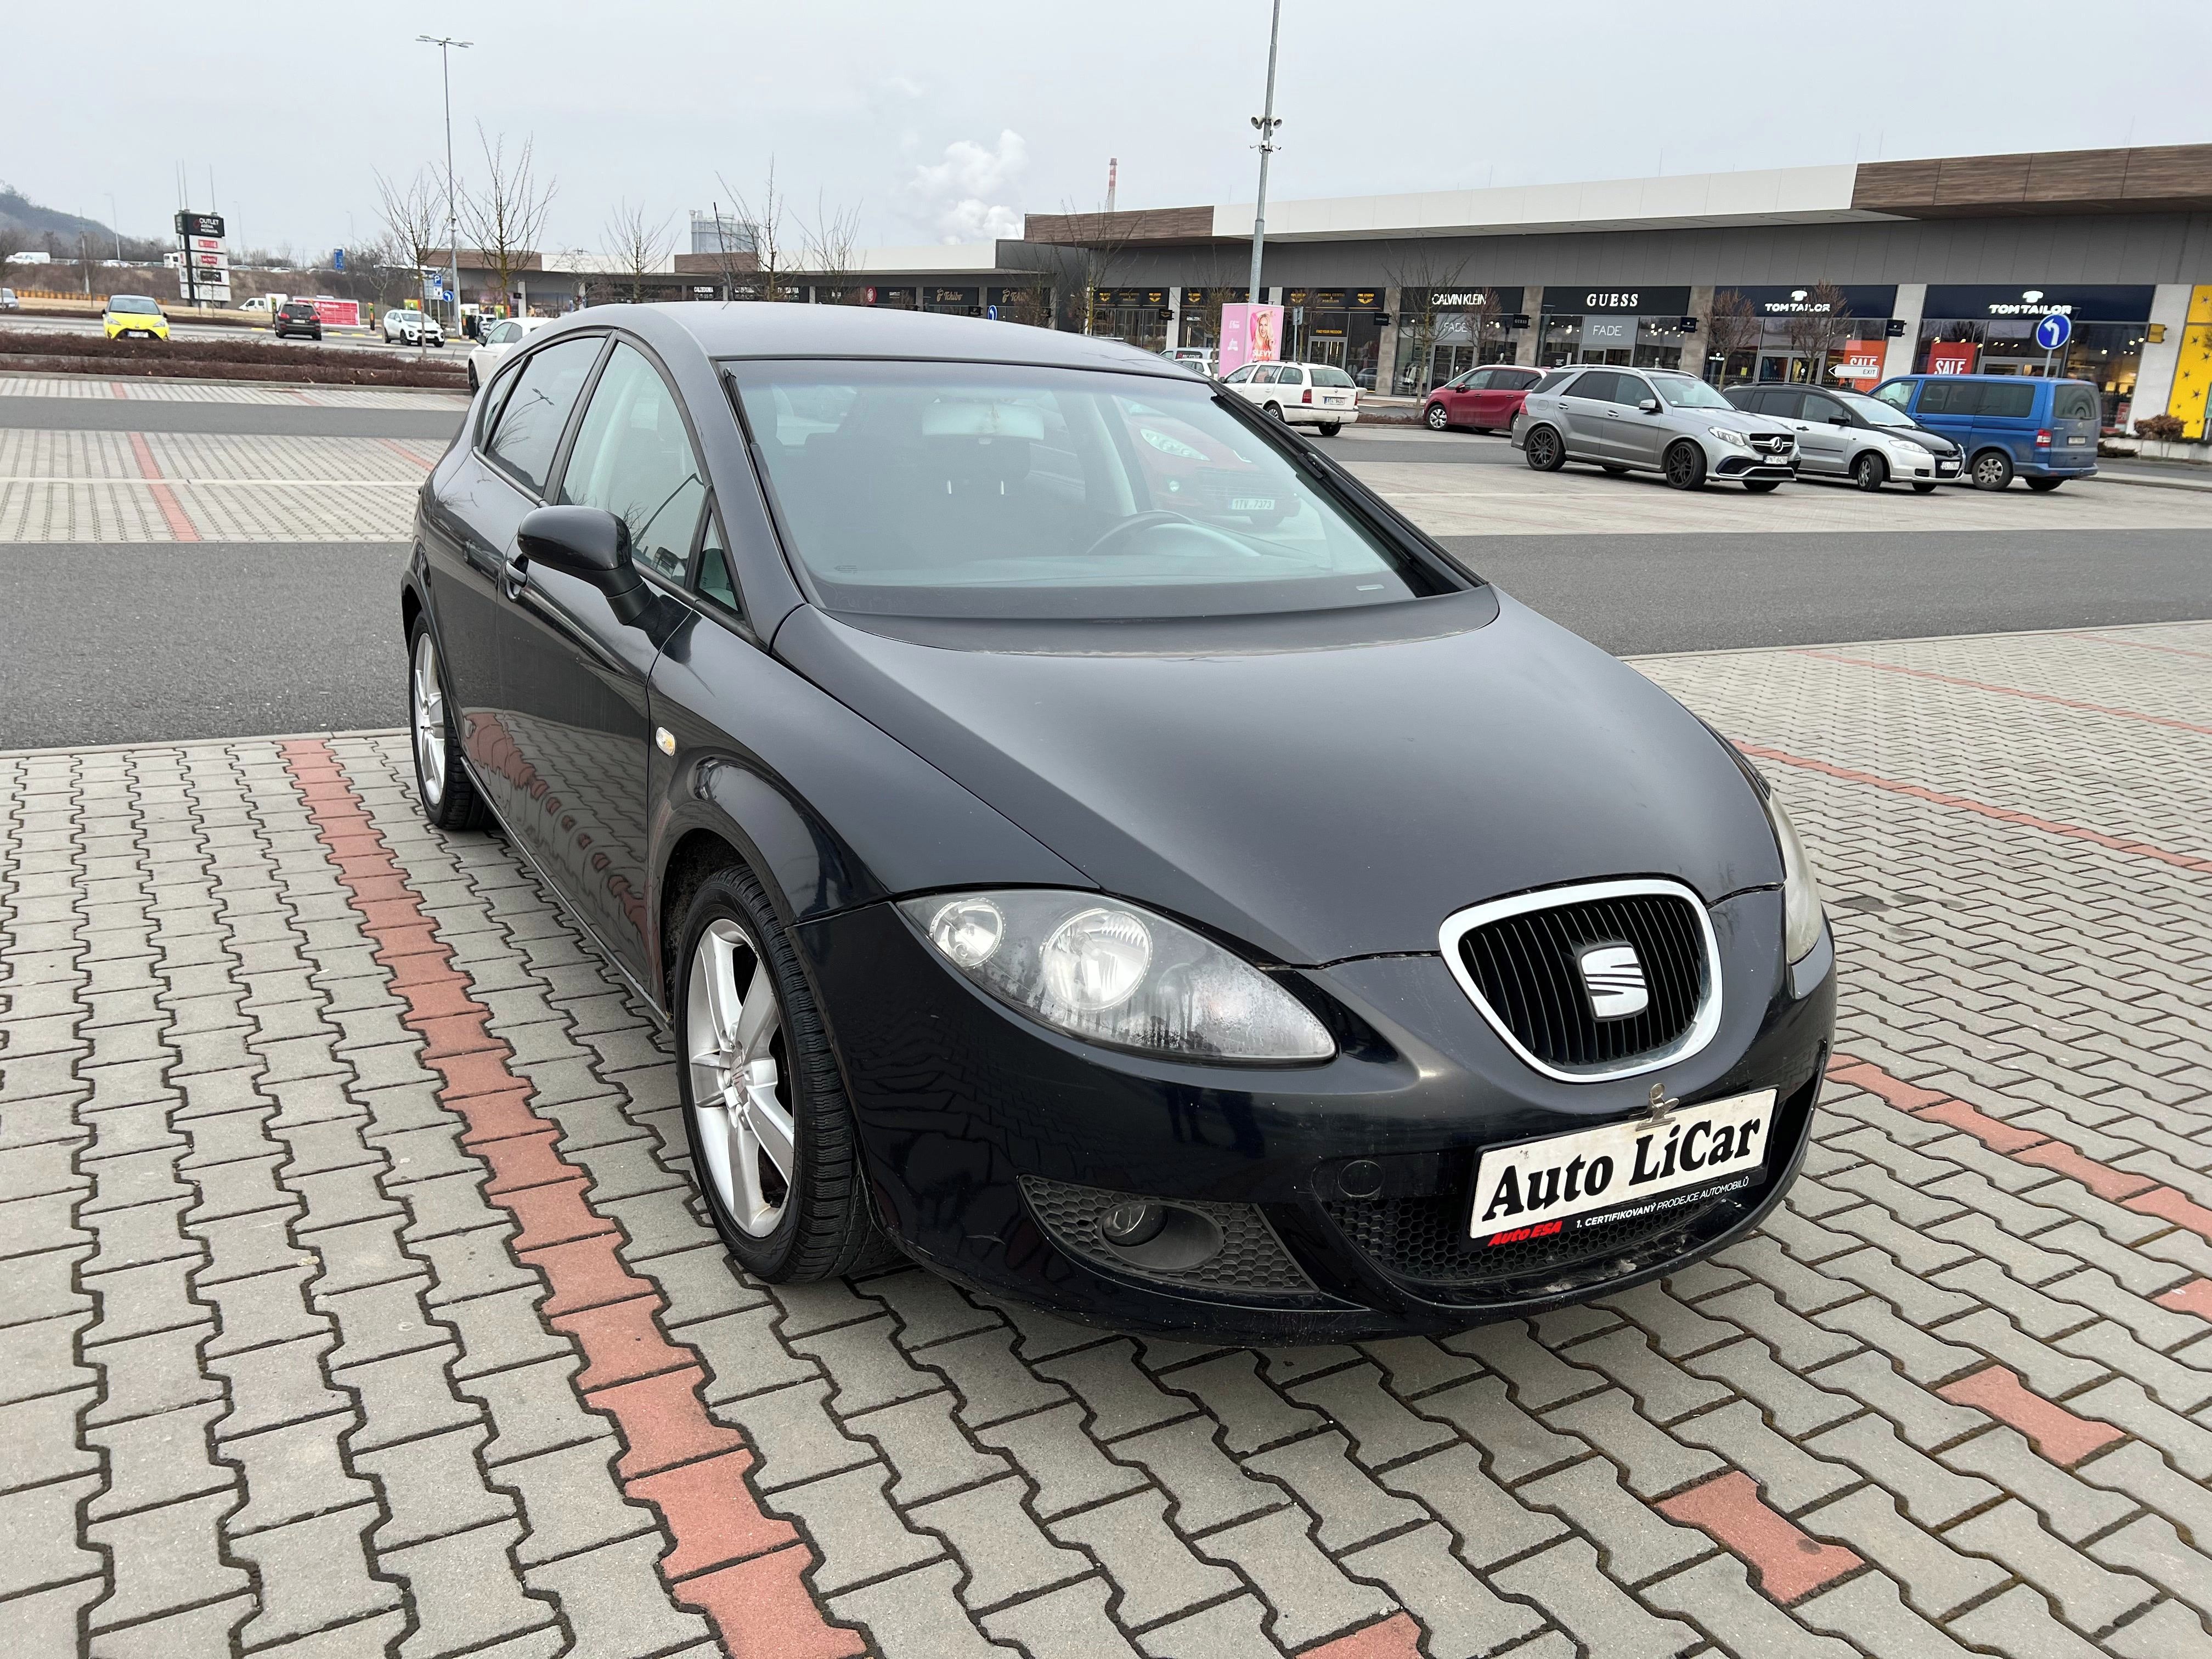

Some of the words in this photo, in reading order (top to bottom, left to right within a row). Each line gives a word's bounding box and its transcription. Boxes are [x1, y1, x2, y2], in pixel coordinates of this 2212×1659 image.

[944, 291, 963, 301] Tchibo
[1432, 294, 1462, 305] CALVIN
[1463, 294, 1487, 305] KLEIN
[1587, 294, 1638, 307] GUESS
[1765, 303, 1788, 312] TOM
[1790, 303, 1830, 312] TAILOR
[1989, 304, 2020, 314] TOM
[2021, 305, 2072, 314] TAILOR
[1443, 322, 1468, 332] FADE
[1593, 325, 1622, 336] FADE
[1934, 360, 1966, 374] SALE
[1254, 500, 1272, 509] 7373
[1482, 1154, 1613, 1222] Auto
[1629, 1118, 1760, 1186] LiCar
[1576, 1220, 1582, 1228] 1.
[1585, 1202, 1656, 1227] CERTIFIKOVANÝ
[1656, 1192, 1700, 1211] PRODEJCE
[1700, 1176, 1749, 1200] AUTOMOBILŮ
[1530, 1220, 1563, 1238] ESA
